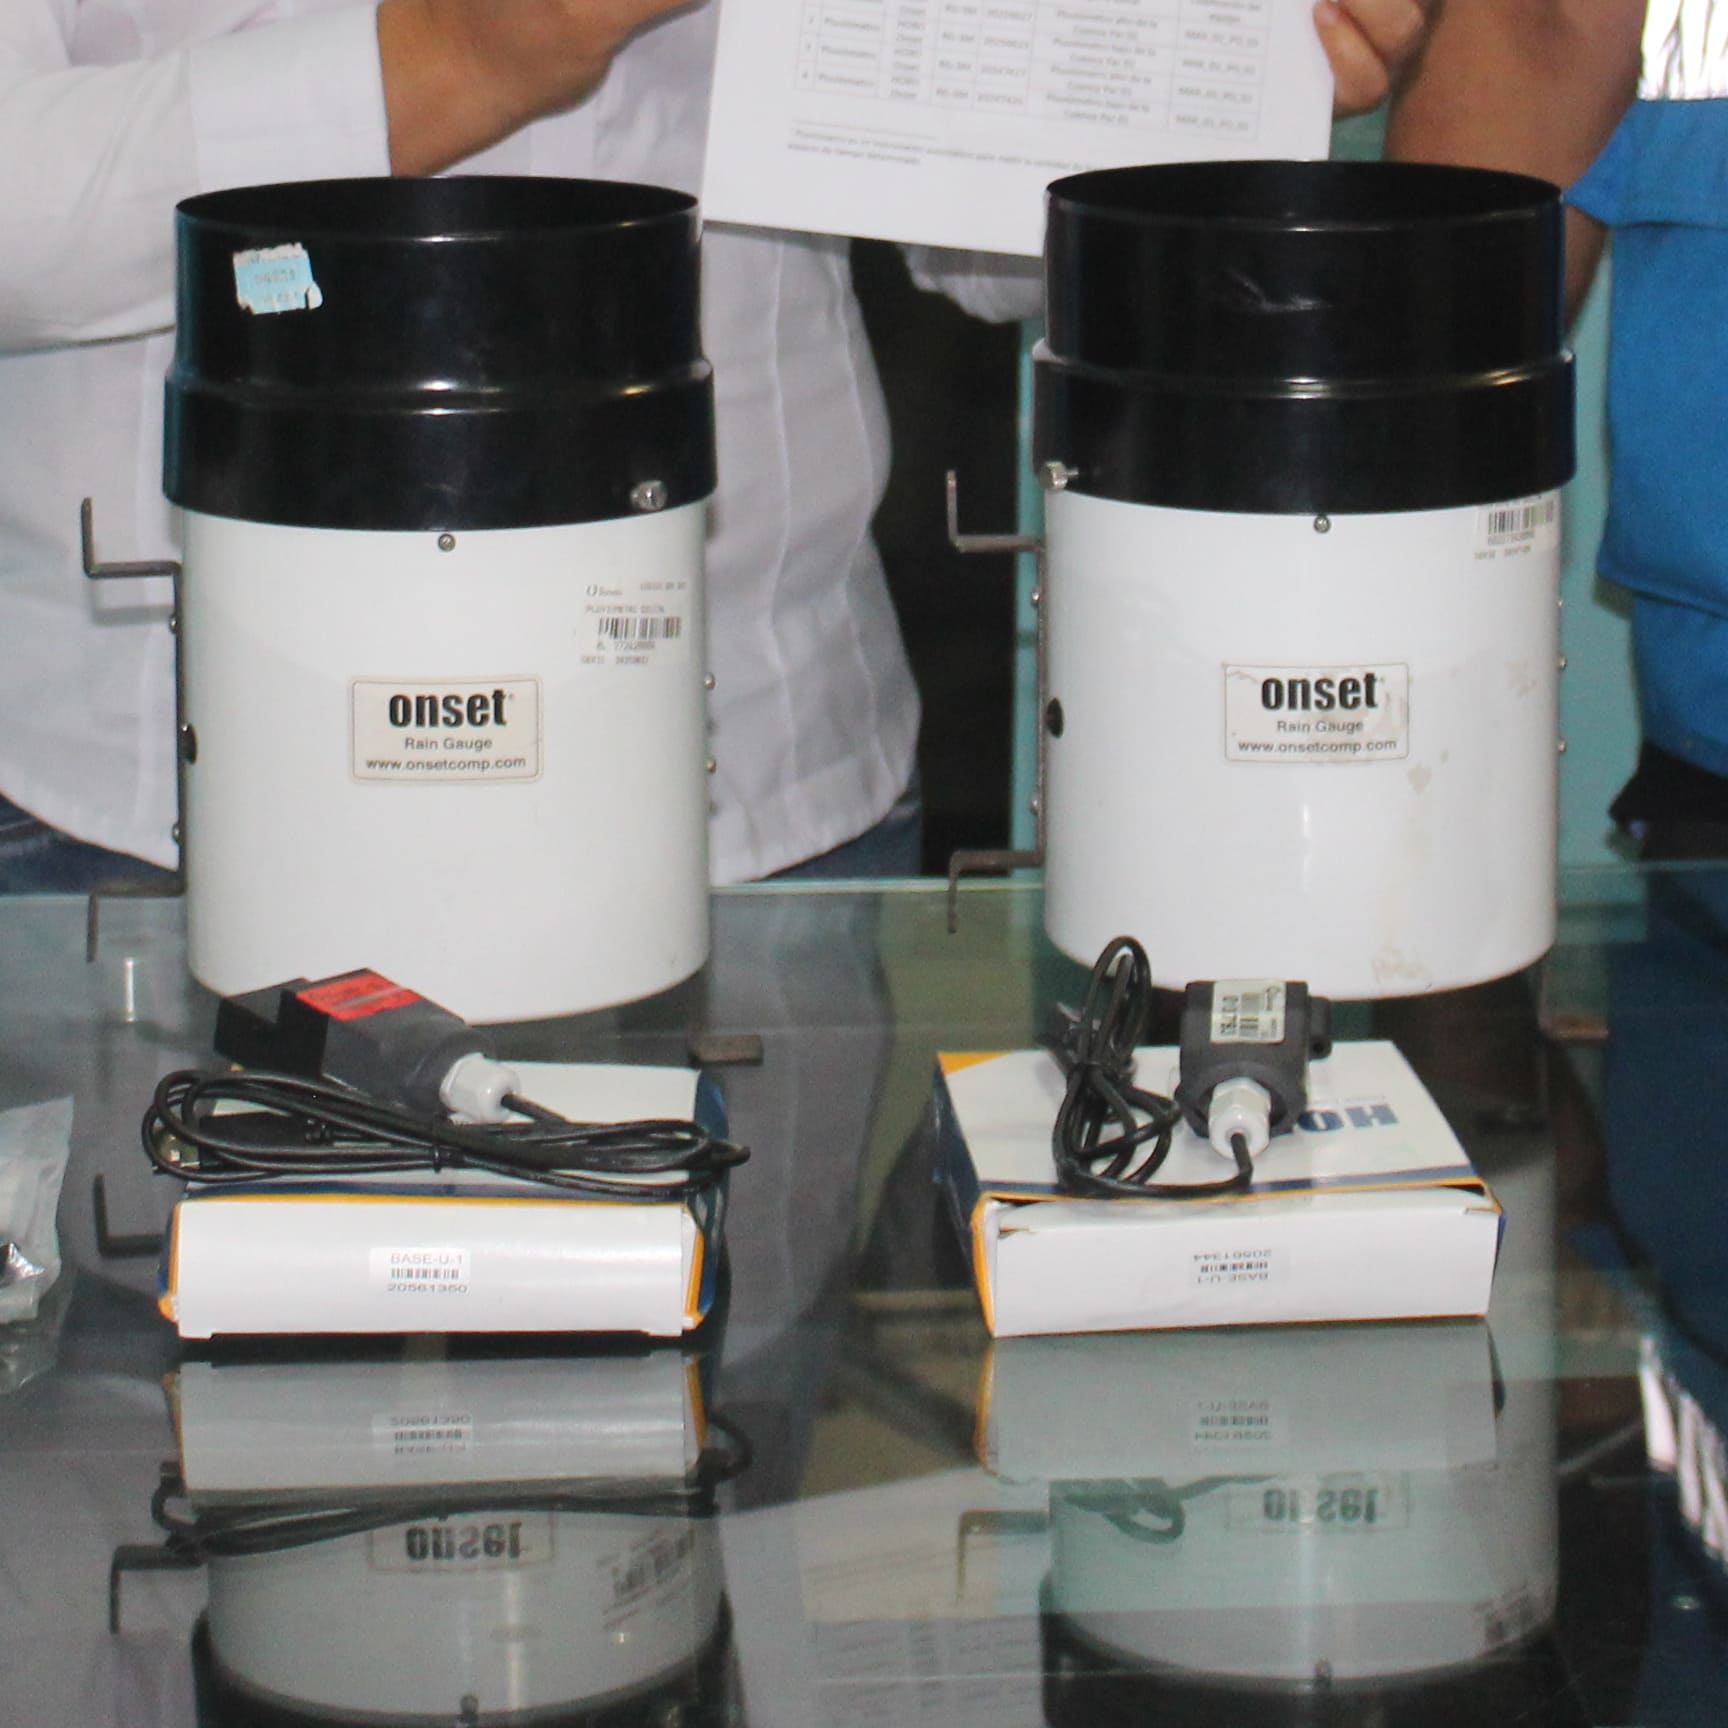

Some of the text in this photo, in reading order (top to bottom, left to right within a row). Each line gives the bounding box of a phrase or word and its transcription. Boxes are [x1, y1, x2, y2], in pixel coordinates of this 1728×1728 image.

[1261, 671, 1379, 712] onset
[388, 688, 508, 731] onset
[1276, 718, 1365, 736] Rain Gauge
[404, 735, 493, 754] Rain Gauge
[1238, 737, 1398, 755] www.onsetcomp.com
[366, 754, 527, 774] www.onsetcomp.com
[390, 1252, 464, 1265] BASE-U-1
